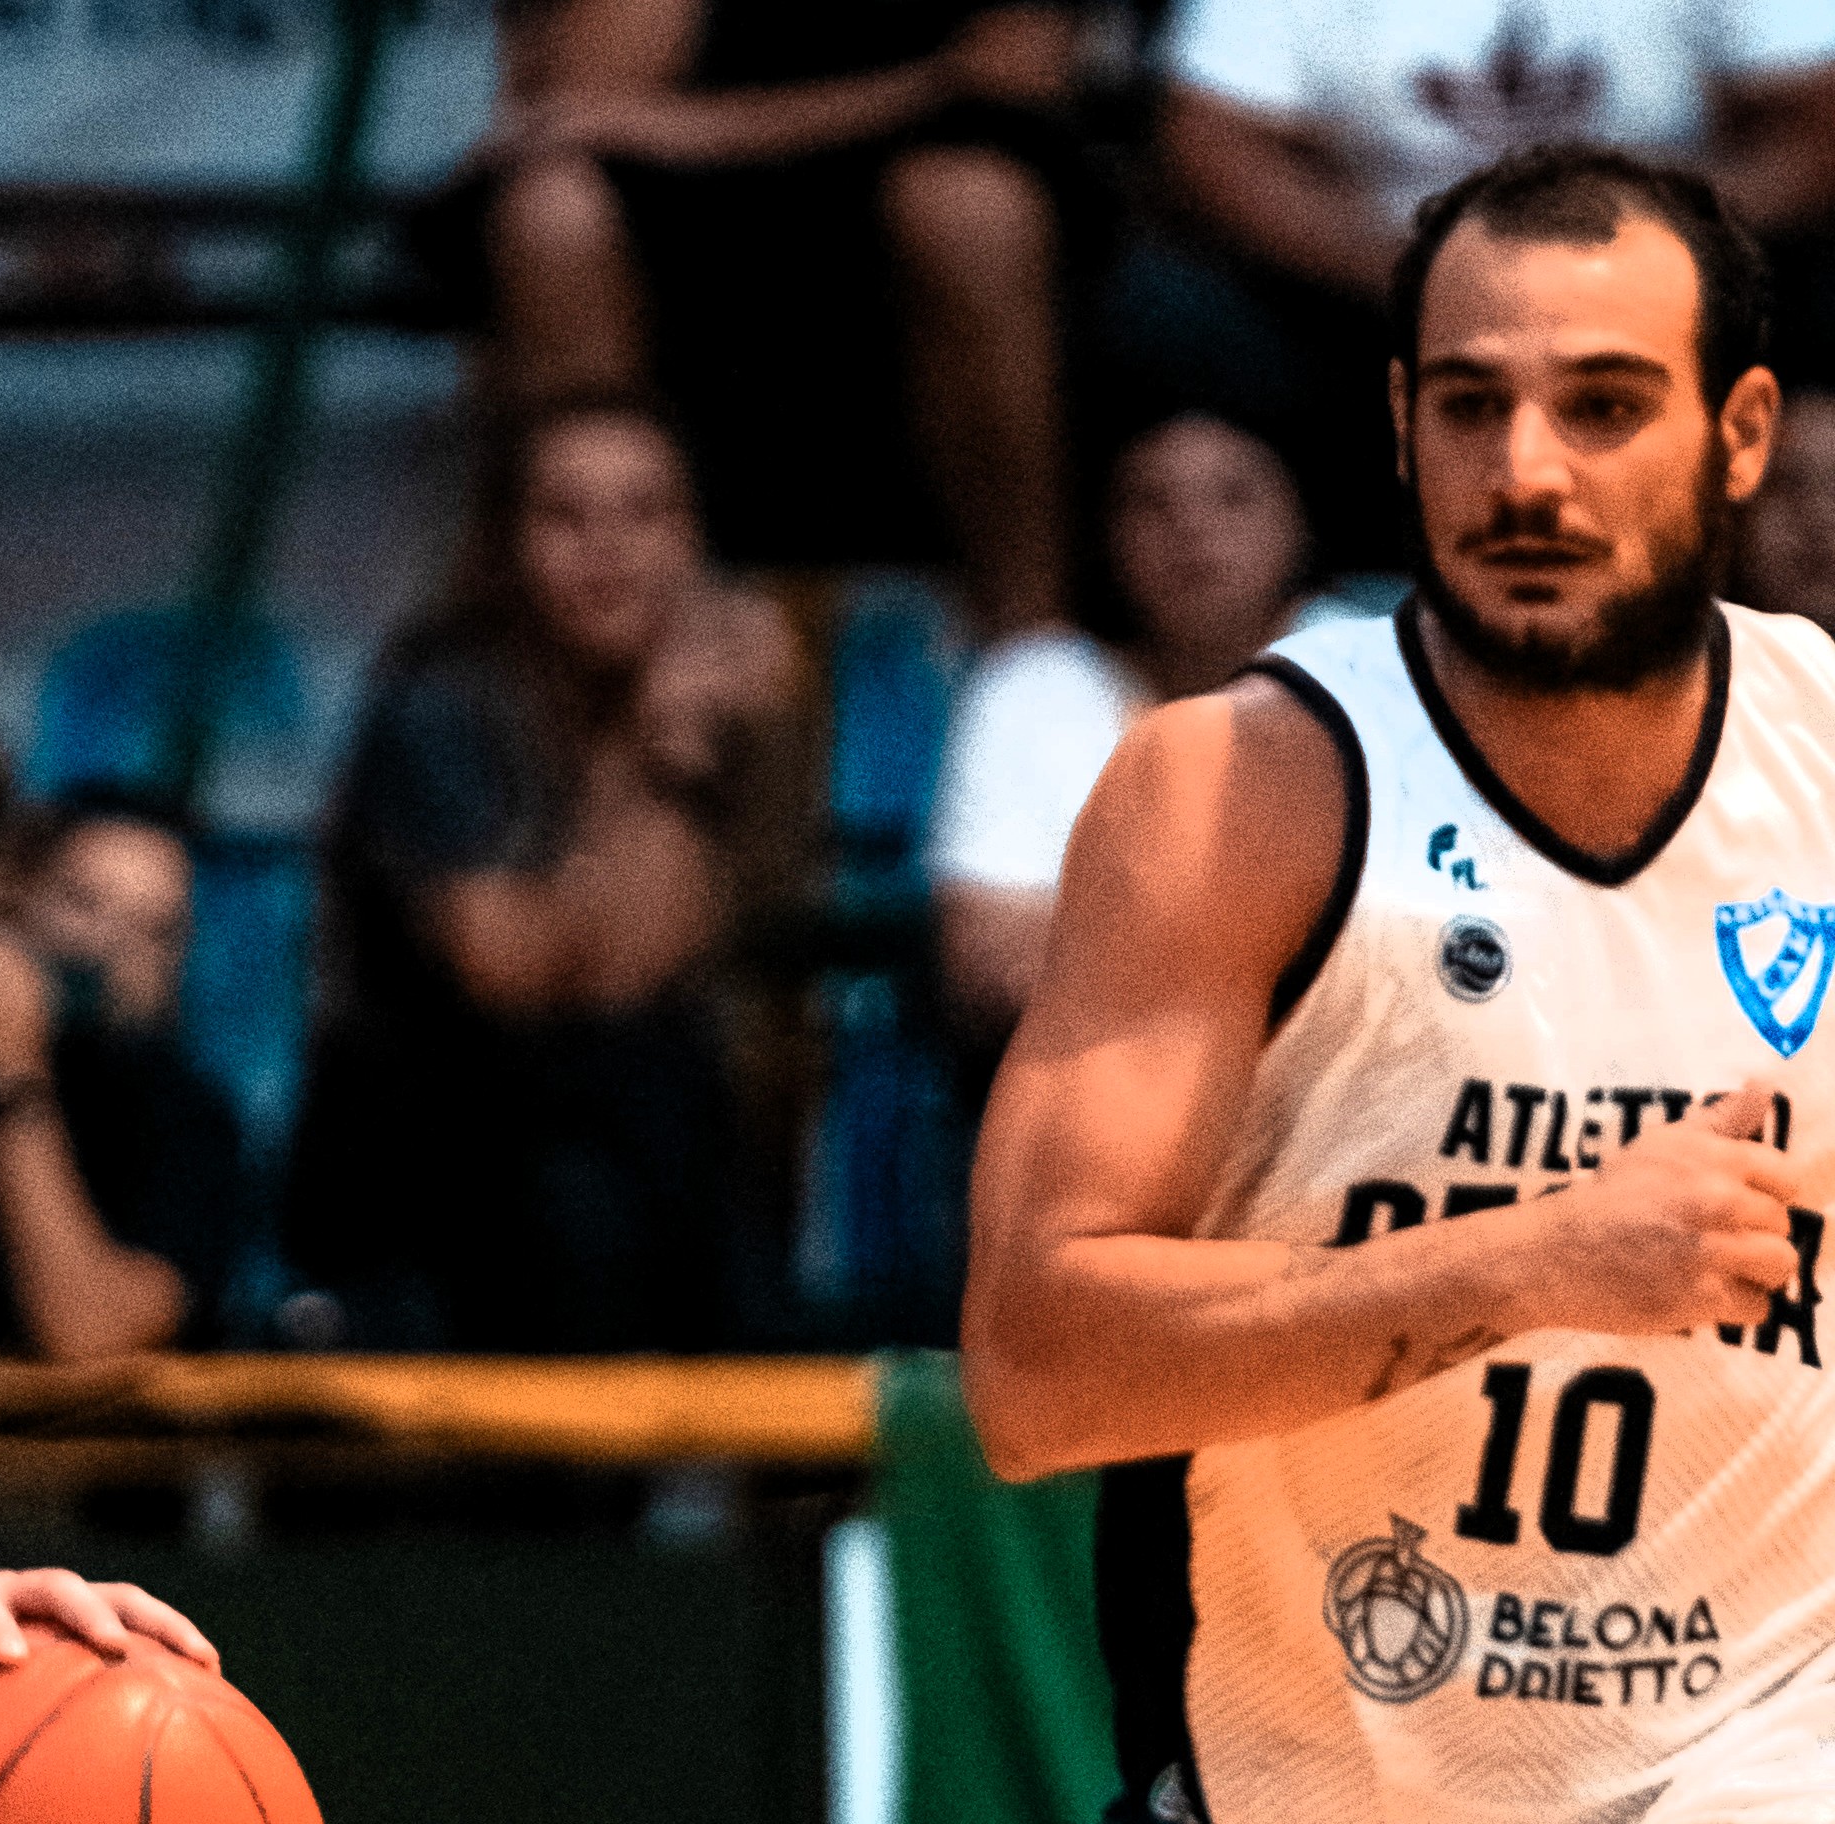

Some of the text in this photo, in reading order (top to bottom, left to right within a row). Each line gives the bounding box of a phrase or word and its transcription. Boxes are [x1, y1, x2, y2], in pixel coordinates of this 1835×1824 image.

[1439, 1078, 1793, 1172] ATLET
[1454, 1362, 1657, 1557] 10
[1488, 1593, 1722, 1651] BELONA
